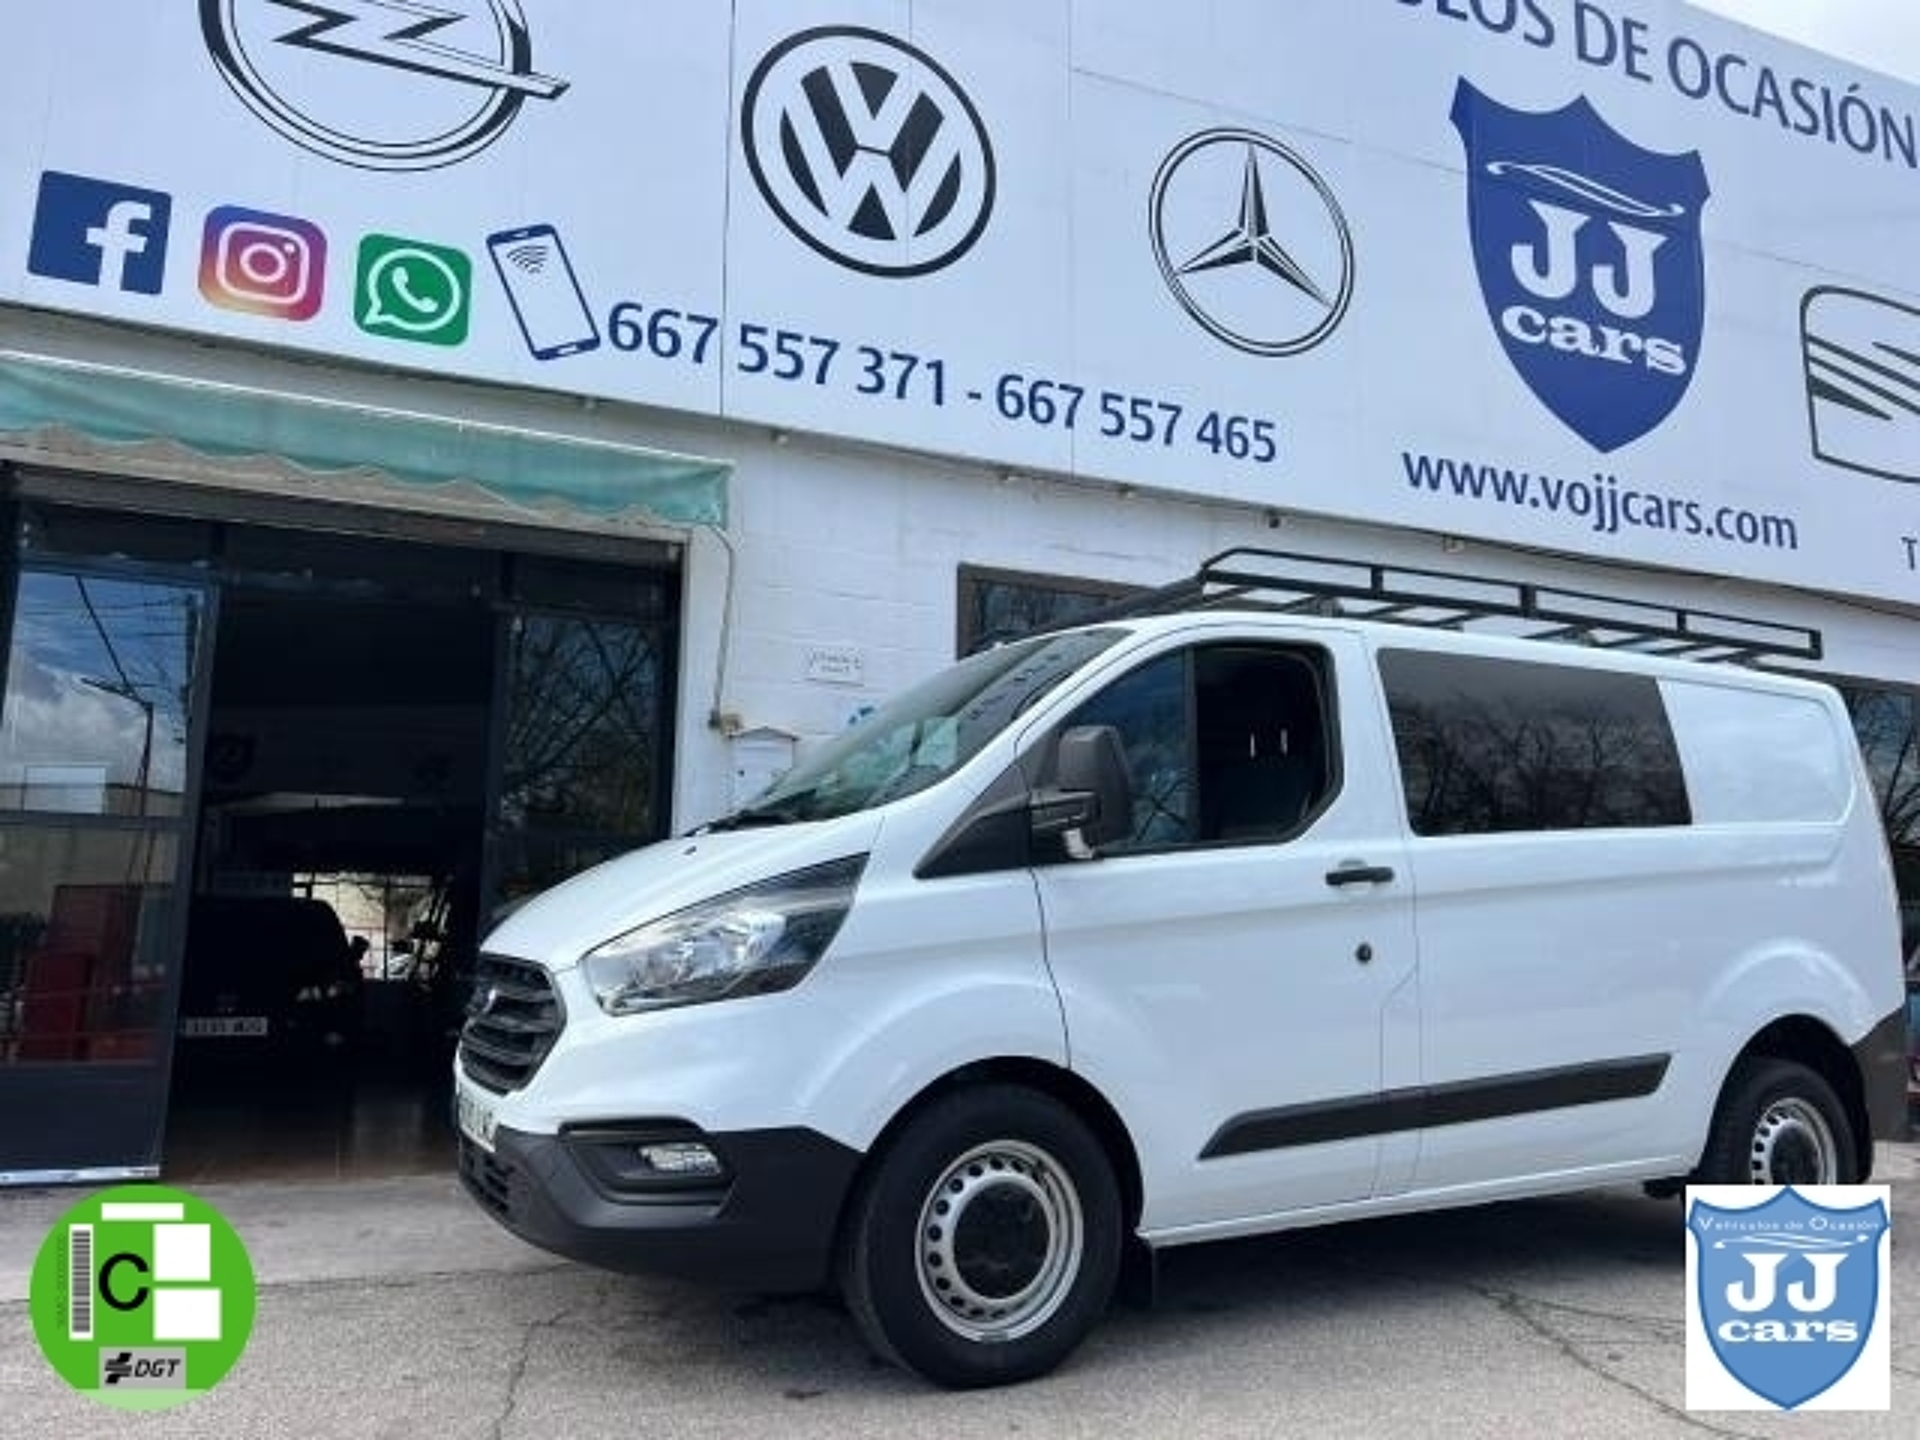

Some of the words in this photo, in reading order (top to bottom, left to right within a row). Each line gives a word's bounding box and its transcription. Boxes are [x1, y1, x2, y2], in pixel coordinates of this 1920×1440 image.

[1574, 0, 1652, 83] DE
[1667, 36, 1918, 168] OCASIÓN
[608, 301, 718, 364] 667
[737, 323, 840, 385] 557
[856, 346, 943, 406] 371
[996, 373, 1084, 429] 667
[1100, 393, 1182, 446] 557
[1196, 411, 1276, 463] 465
[1502, 305, 1686, 375] cars
[1402, 451, 1799, 550] www.vojjcars.com
